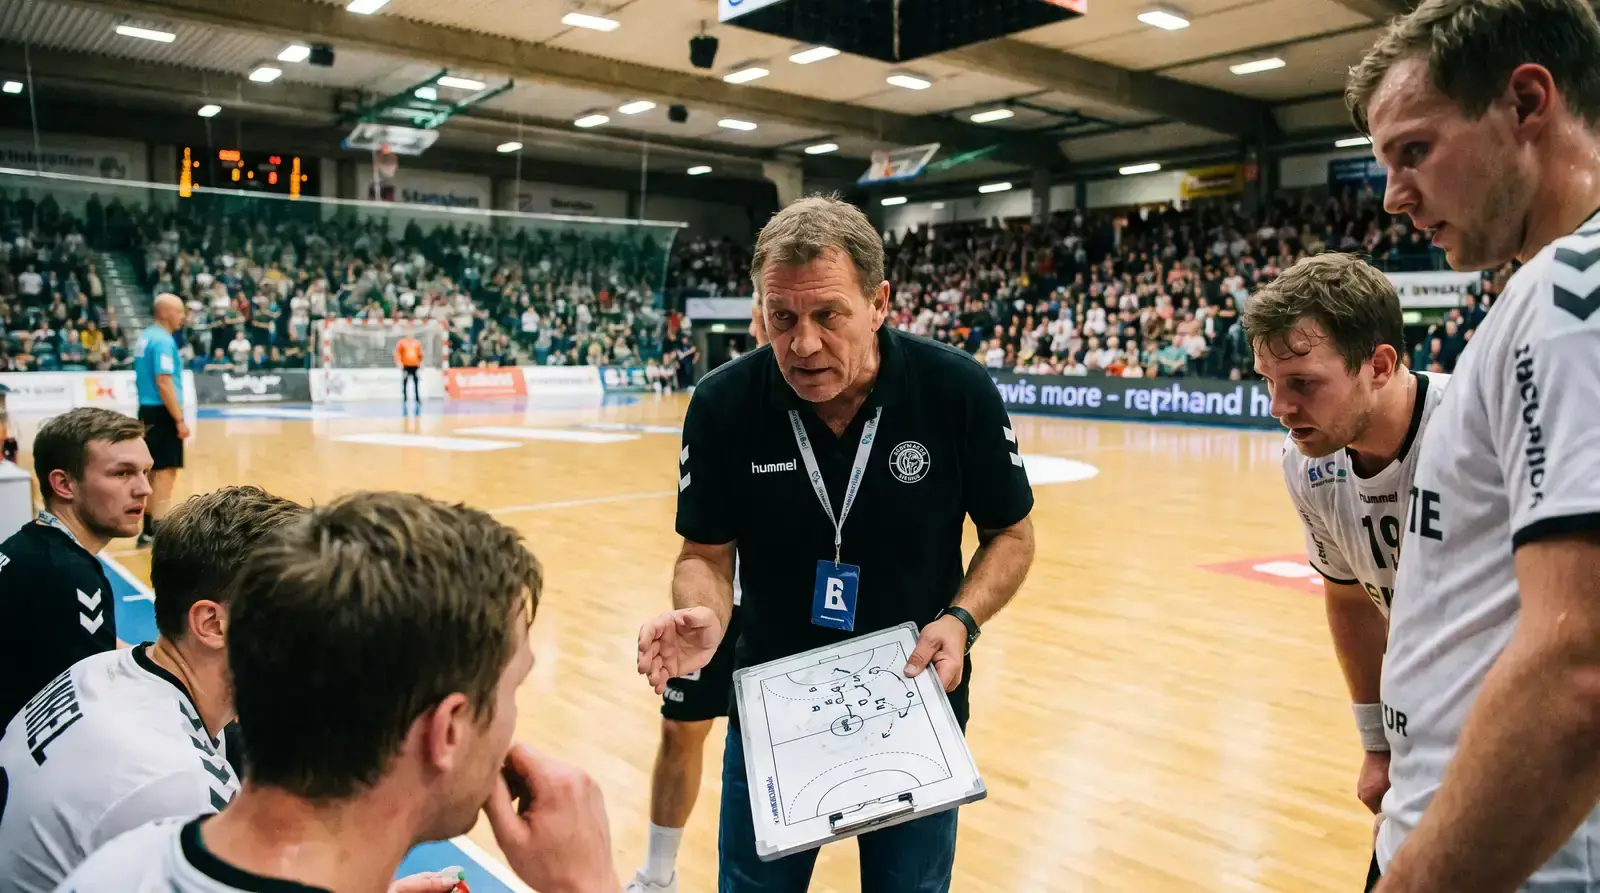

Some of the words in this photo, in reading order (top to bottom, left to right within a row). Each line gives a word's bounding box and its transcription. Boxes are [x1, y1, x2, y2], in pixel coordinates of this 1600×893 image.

[992, 377, 1036, 405] avis
[1041, 384, 1102, 408] more
[1250, 385, 1273, 417] h
[751, 458, 797, 474] hummel
[1359, 491, 1398, 504] hummel
[1361, 515, 1400, 571] 19
[1382, 701, 1408, 738] UR
